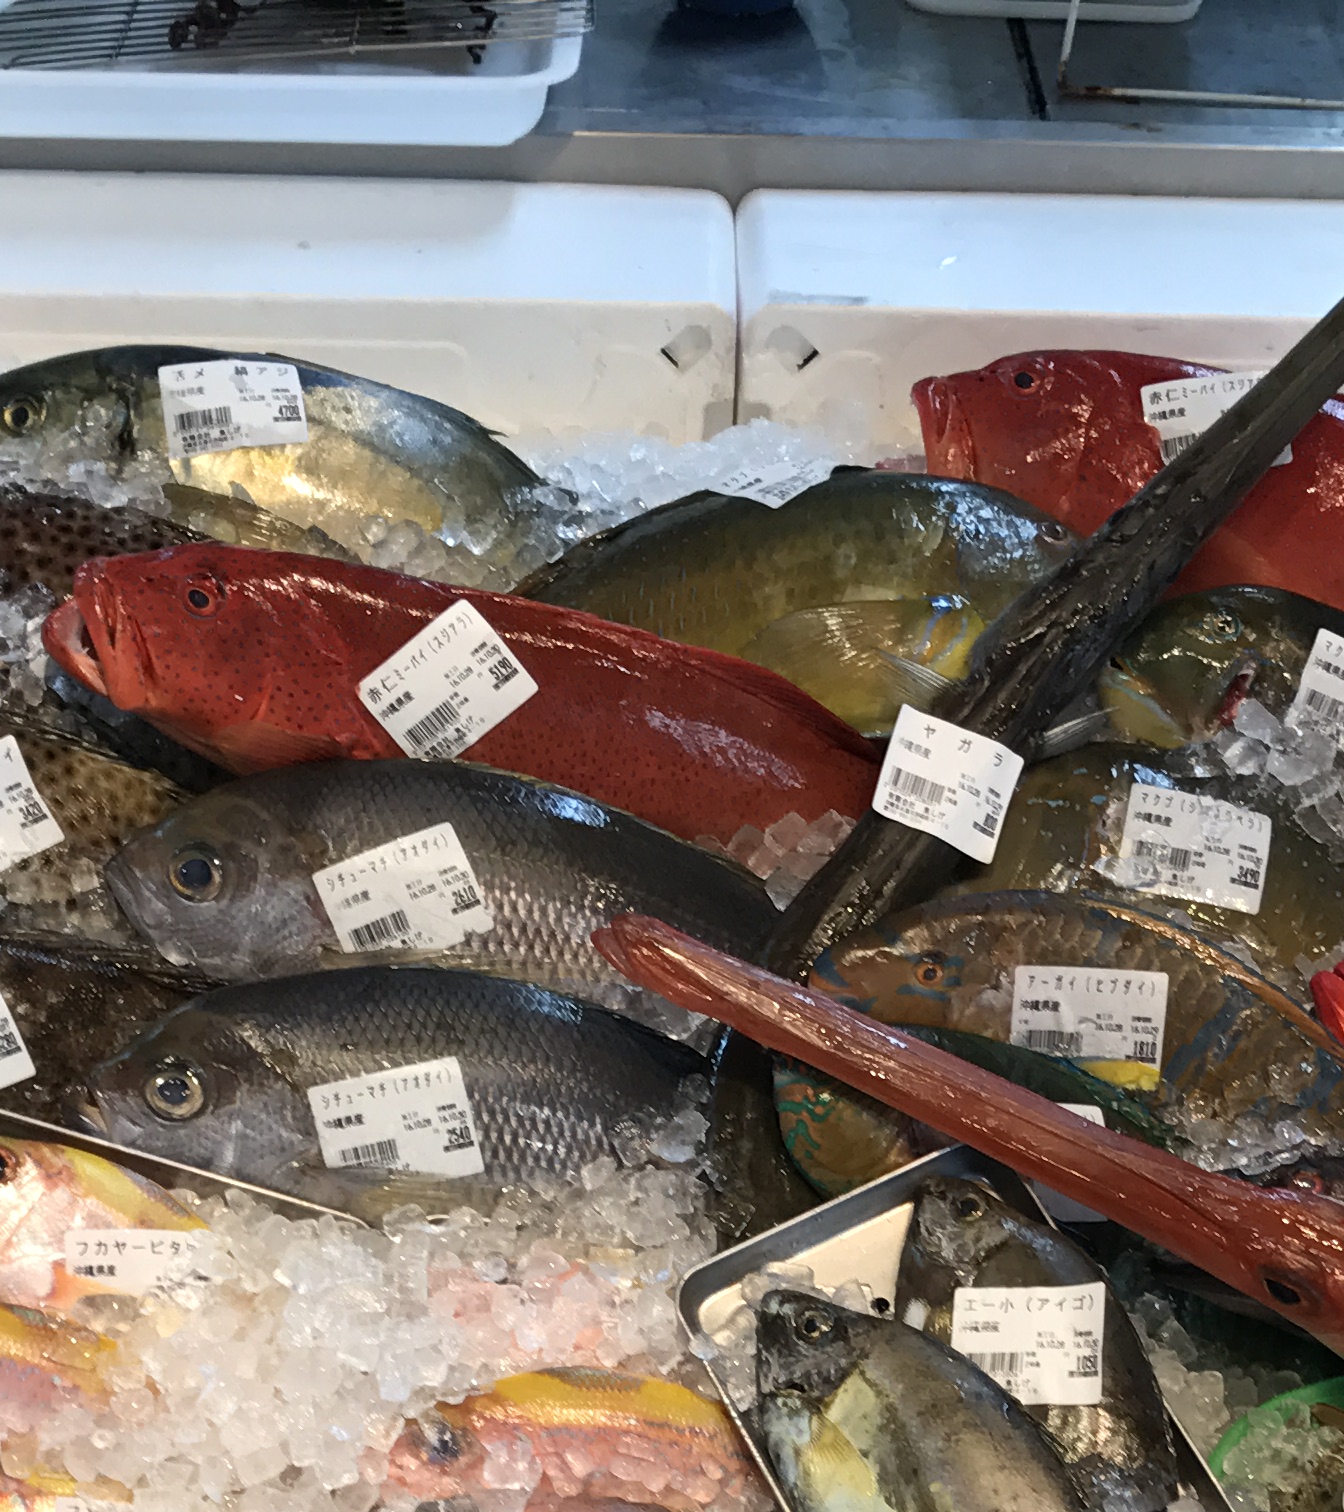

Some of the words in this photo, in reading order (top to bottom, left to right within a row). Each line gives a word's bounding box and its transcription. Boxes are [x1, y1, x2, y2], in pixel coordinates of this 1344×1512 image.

[1149, 378, 1255, 405] 赤仁ミーバイ（スジア
[278, 404, 300, 417] 4700
[368, 612, 473, 704] 赤仁ミーバイ（スジアラ）
[492, 657, 514, 682] 5190
[923, 724, 1003, 767] ヤガラ
[20, 801, 42, 821] 3420
[326, 831, 449, 892] シチューマチ（アオダイ）
[1237, 865, 1260, 882] 3490
[452, 886, 477, 906] 2610
[1027, 974, 1156, 998] アーガイ（ヒブダイ）
[1020, 999, 1061, 1013] 沖縄県産
[1133, 1040, 1156, 1057] 1810
[321, 1070, 452, 1110] シチューマチ（アオダイ）
[447, 1126, 471, 1144] 2540
[74, 1265, 116, 1278] 沖縄県産
[965, 1294, 1095, 1315] エー小（アイゴ）
